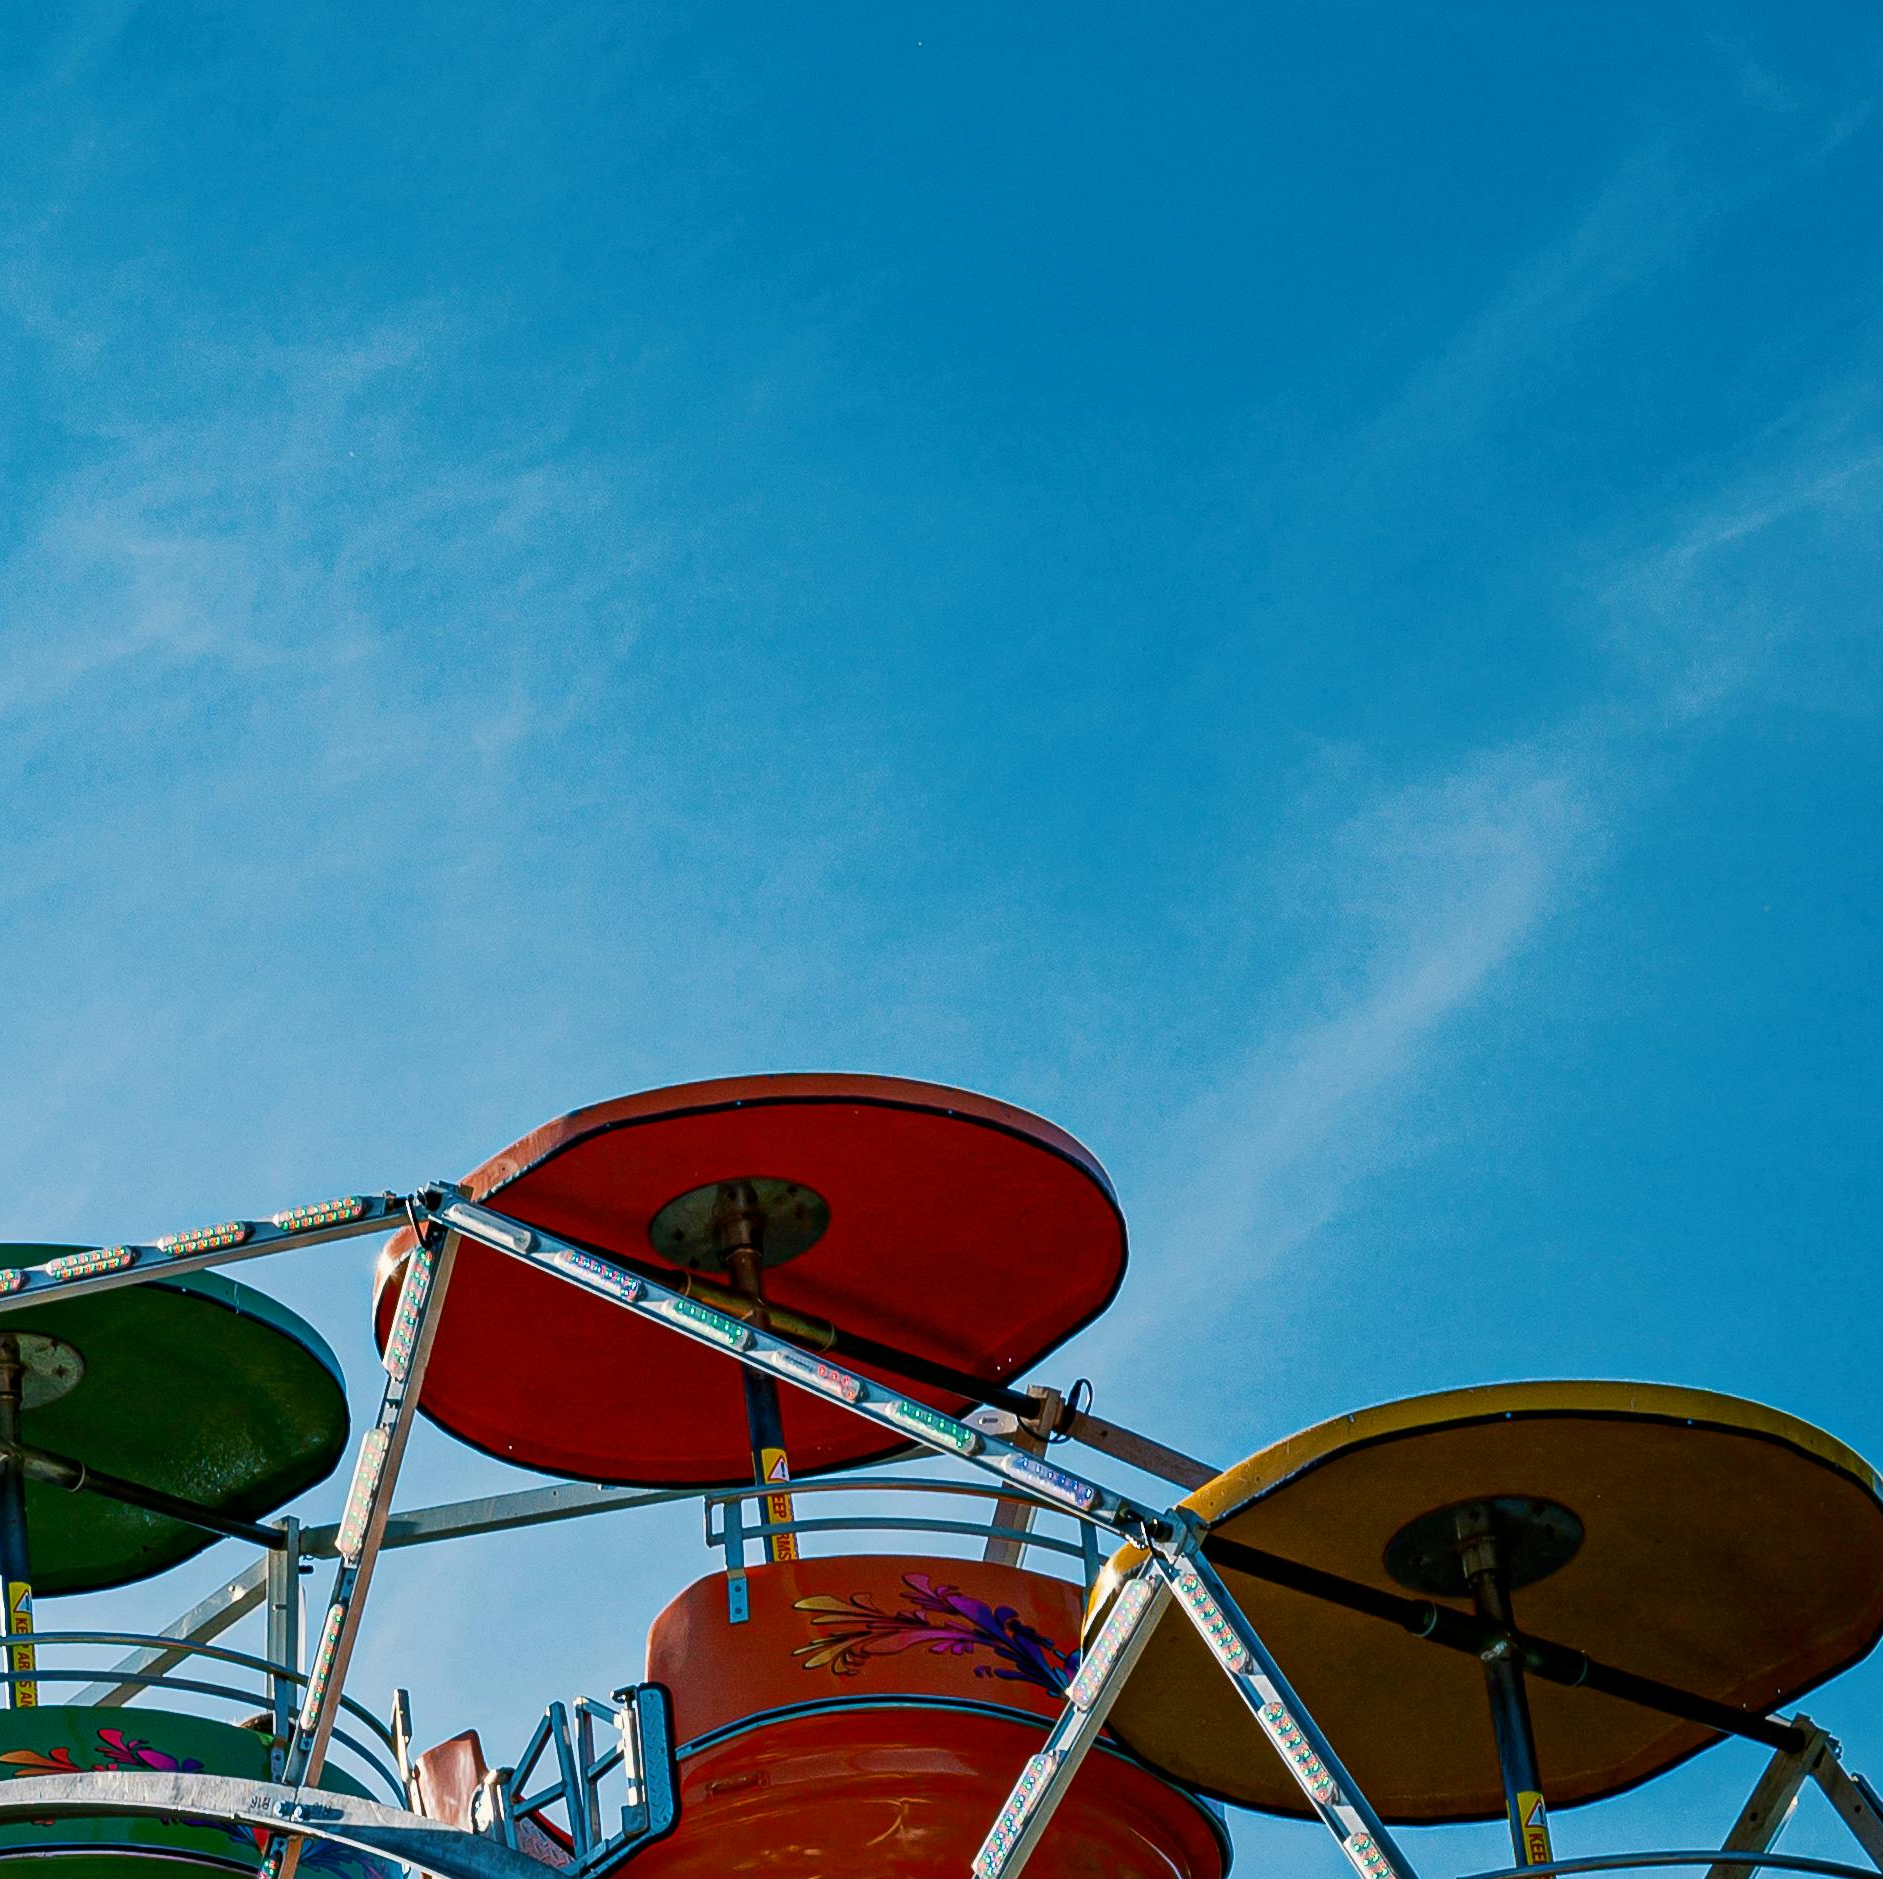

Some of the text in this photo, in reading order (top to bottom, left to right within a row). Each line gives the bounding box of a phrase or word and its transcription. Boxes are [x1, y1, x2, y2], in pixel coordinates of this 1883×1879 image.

[772, 1494, 792, 1561] EEP RMS
[18, 1652, 32, 1688] ARS
[20, 1691, 33, 1706] AN
[1529, 1833, 1548, 1865] KEE
